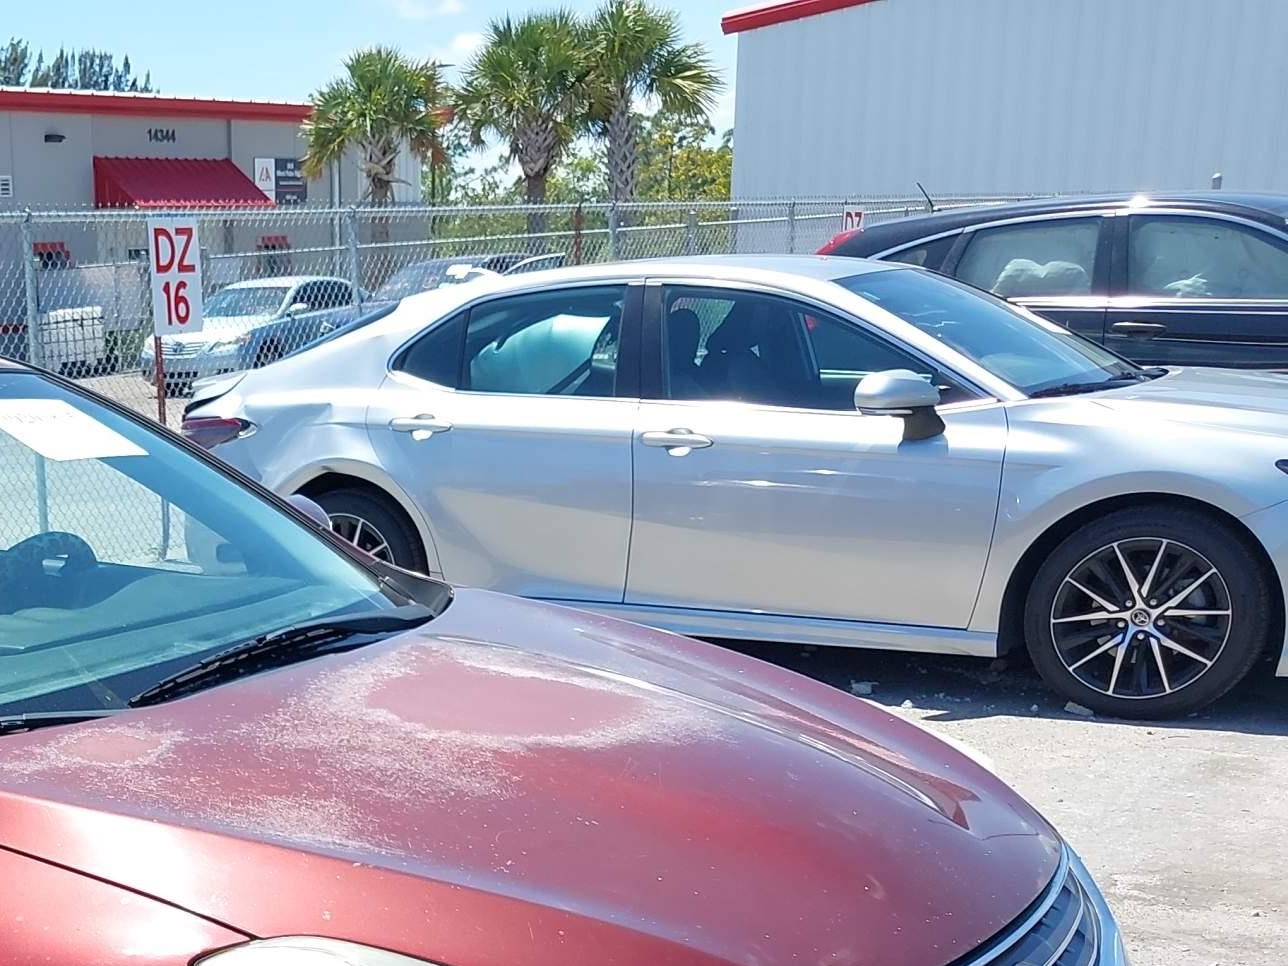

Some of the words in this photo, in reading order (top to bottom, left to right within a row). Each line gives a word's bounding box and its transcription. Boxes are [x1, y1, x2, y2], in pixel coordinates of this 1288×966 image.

[146, 127, 177, 143] 14344
[153, 227, 196, 273] DZ
[162, 280, 190, 326] 16
